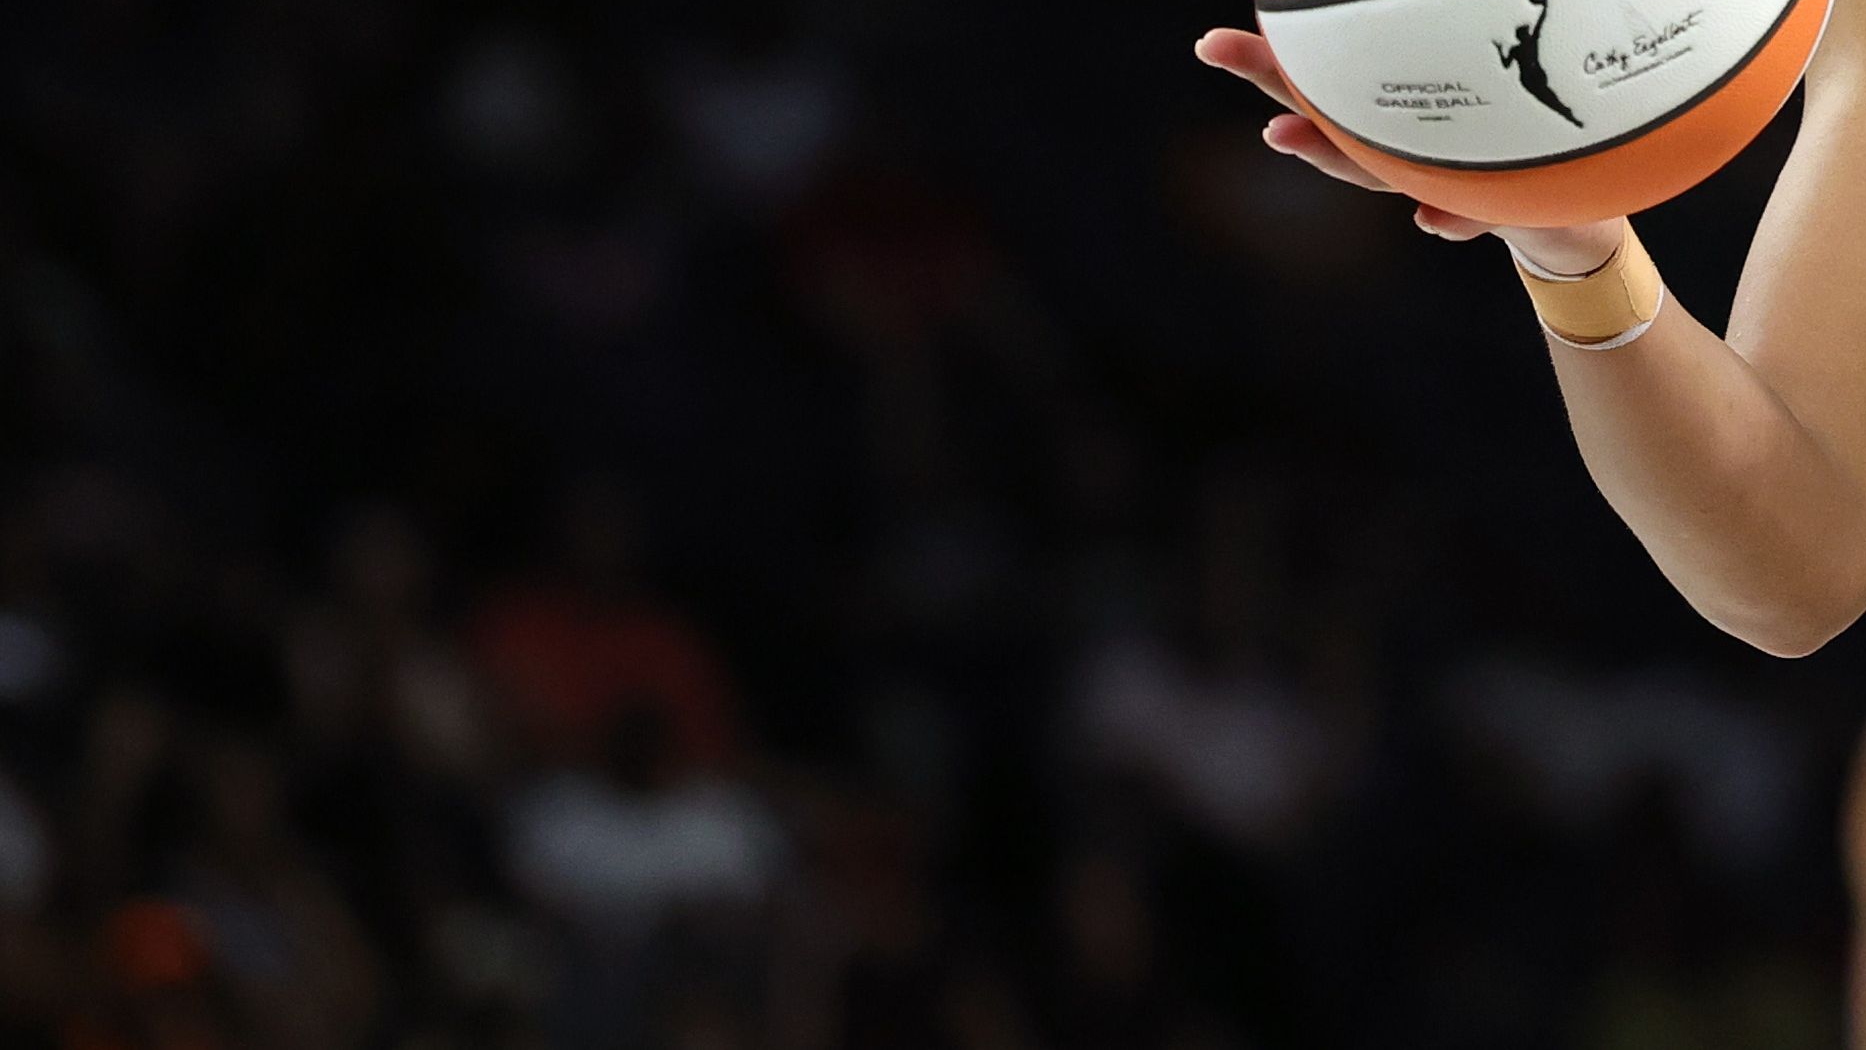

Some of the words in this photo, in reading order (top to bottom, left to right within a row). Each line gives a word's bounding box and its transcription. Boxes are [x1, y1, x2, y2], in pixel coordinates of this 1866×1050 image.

[1381, 82, 1470, 93] OFFICIAL
[1376, 96, 1432, 109] GAME
[1435, 96, 1492, 109] BALL
